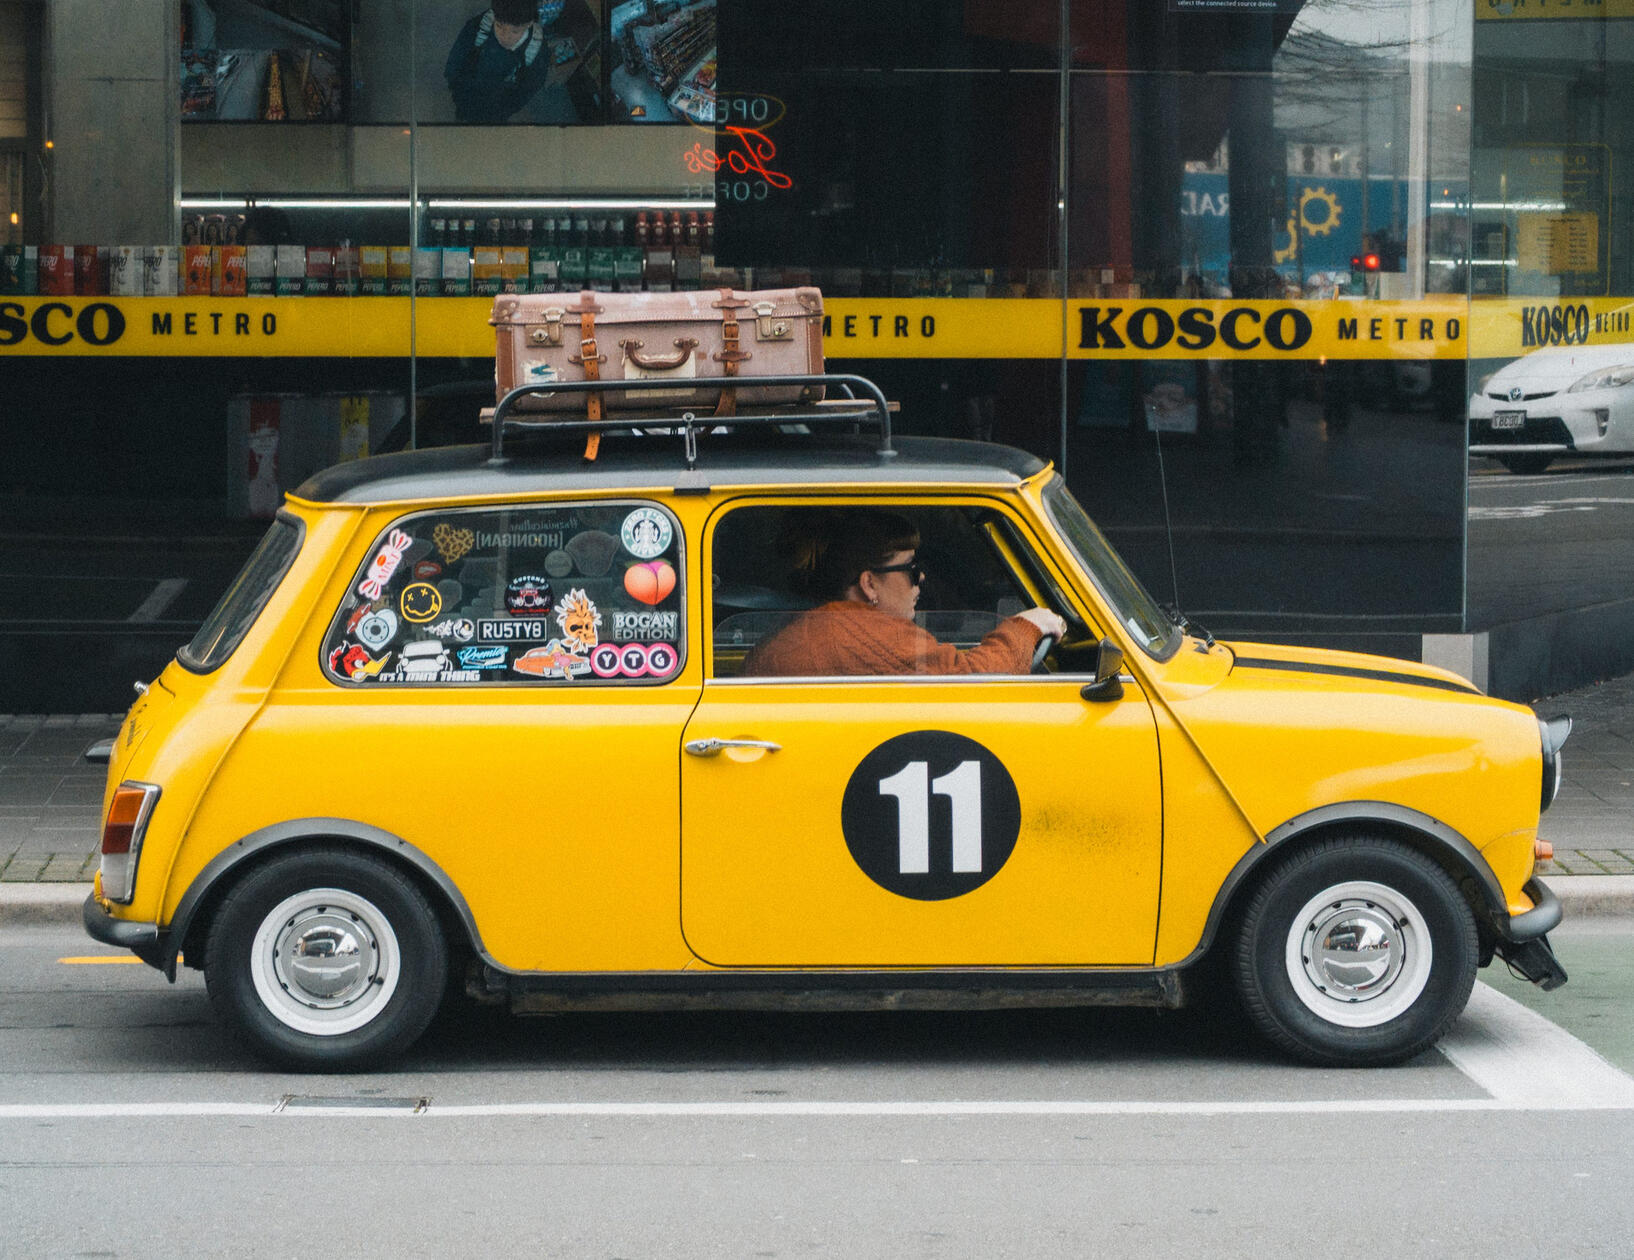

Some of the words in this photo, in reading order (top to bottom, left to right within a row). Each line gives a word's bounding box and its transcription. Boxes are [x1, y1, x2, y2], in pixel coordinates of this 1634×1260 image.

[153, 313, 278, 335] METRO
[1079, 307, 1312, 350] KOSCO
[1338, 318, 1461, 341] METRO
[1522, 304, 1589, 347] KOSCO
[1596, 312, 1630, 333] METRO
[614, 612, 676, 629] BOGAN
[614, 629, 675, 640] EDITION
[878, 760, 983, 873] 11
